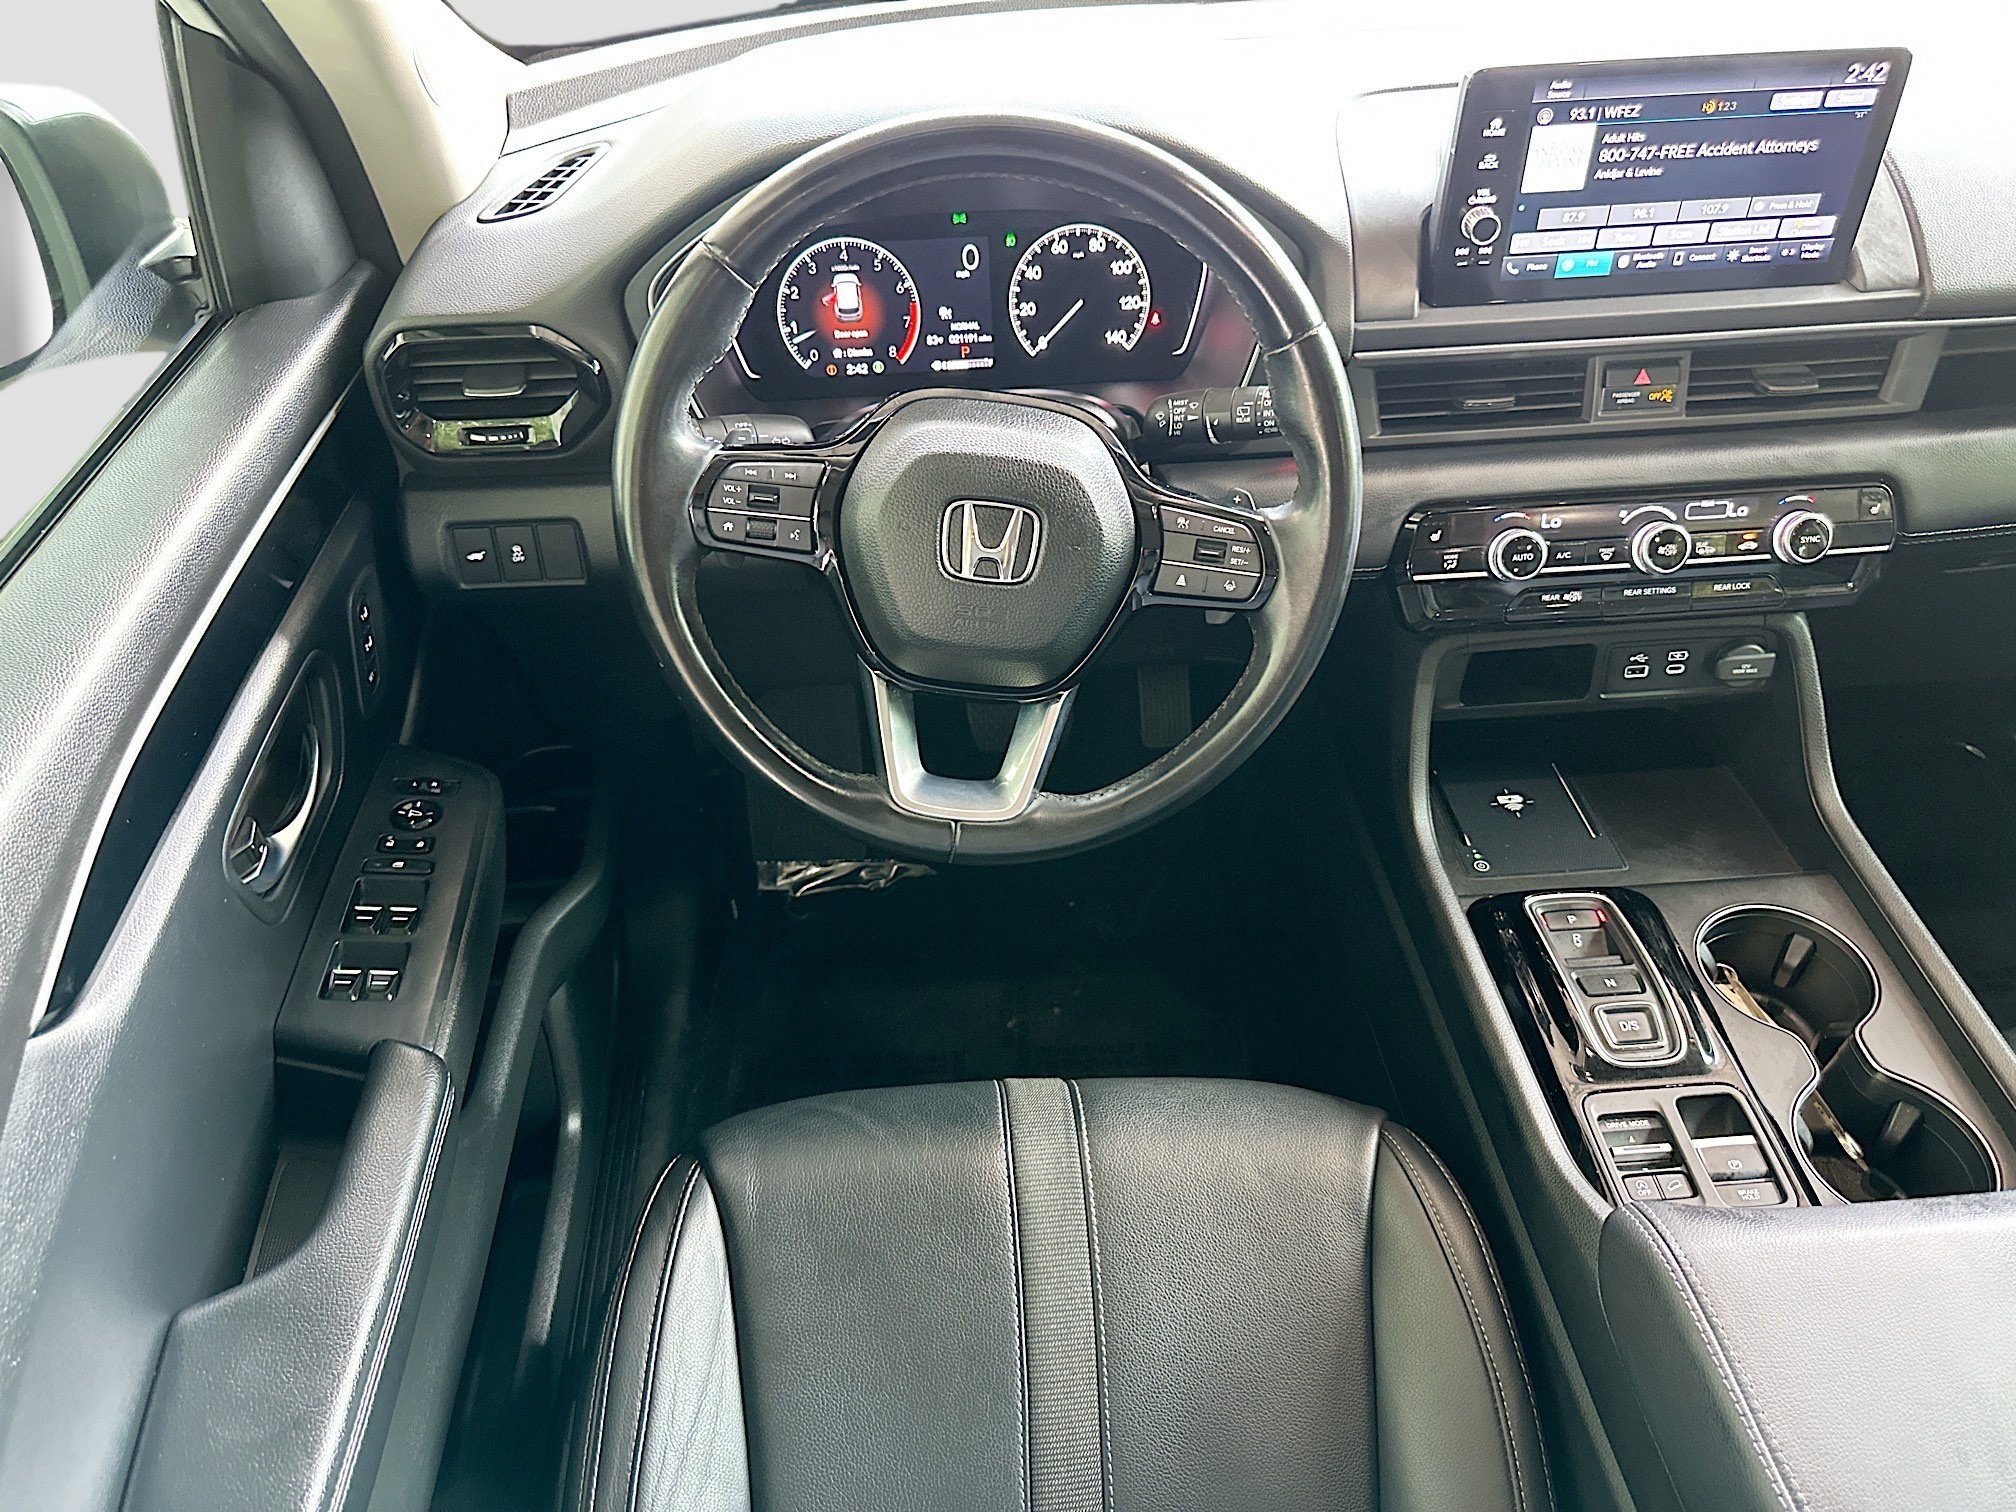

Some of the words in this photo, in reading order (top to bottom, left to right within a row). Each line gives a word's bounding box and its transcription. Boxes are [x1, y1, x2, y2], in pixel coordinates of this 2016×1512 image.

[1844, 61, 1891, 84] 2:42
[1570, 108, 1595, 121] 93.1
[1604, 104, 1642, 119] WFEZ
[1602, 133, 1627, 144] Adult
[1629, 132, 1647, 143] Hits
[1598, 144, 1697, 163] 800-747-FREE
[1697, 141, 1755, 158] Accident
[1755, 138, 1820, 155] Attorneys
[1051, 239, 1069, 255] 60
[1088, 237, 1106, 253] 80
[839, 249, 849, 262] 4
[962, 244, 980, 271] 0
[808, 262, 818, 275] 3
[874, 260, 882, 272] 5
[1110, 260, 1133, 275] 100
[1025, 265, 1042, 280] 40
[790, 286, 800, 300] 2
[896, 281, 905, 294] 6
[1119, 295, 1142, 310] 120
[1019, 302, 1037, 317] 20
[790, 321, 798, 334] 1
[903, 316, 911, 329] 7
[1105, 329, 1128, 345] 140
[809, 349, 819, 361] 0
[888, 346, 897, 358] 8
[961, 346, 970, 358] P
[846, 363, 869, 375] 2:42
[1213, 525, 1236, 535] CANCEL
[1801, 535, 1821, 544] SYNC
[1512, 553, 1534, 562] AUTO
[1556, 552, 1572, 560] A/C
[1643, 586, 1677, 596] SETTINGS
[1714, 584, 1732, 592] REAR
[1733, 582, 1751, 590] LOCK
[1567, 914, 1577, 925] P
[1572, 933, 1582, 947] R
[1604, 978, 1617, 988] N
[1619, 1020, 1640, 1032] D/S
[1606, 1121, 1628, 1129] DRIVE
[1629, 1119, 1651, 1128] MODE
[1637, 1189, 1652, 1197] OFF
[1738, 1188, 1759, 1196] BRAKE
